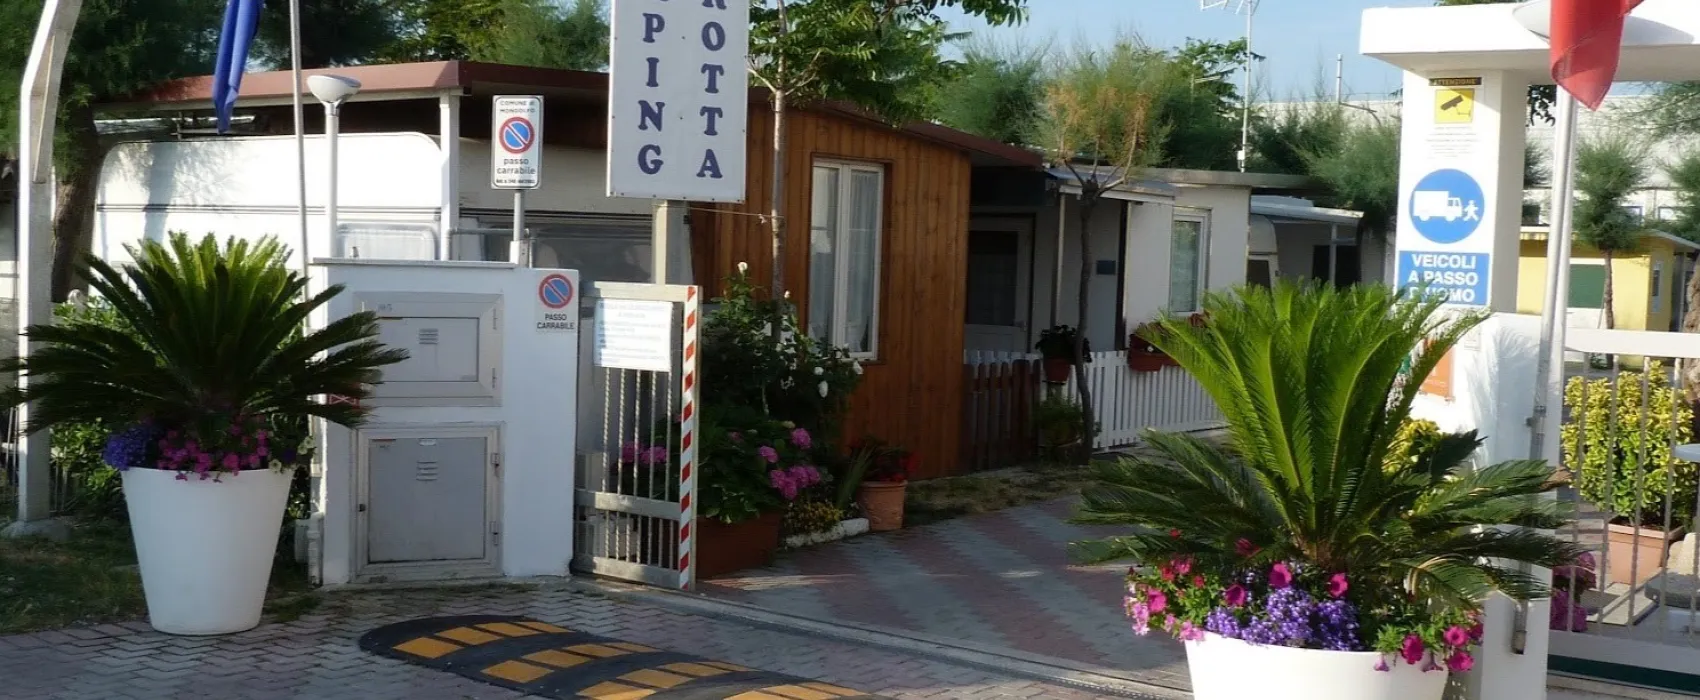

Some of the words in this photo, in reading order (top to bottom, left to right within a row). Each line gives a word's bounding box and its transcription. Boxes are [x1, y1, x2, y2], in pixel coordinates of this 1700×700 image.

[638, 0, 668, 175] PING
[496, 166, 536, 174] carrabile
[503, 158, 529, 166] passo
[1411, 253, 1477, 269] VEICOLI
[1408, 270, 1419, 282] A
[1423, 270, 1479, 286] PASSO
